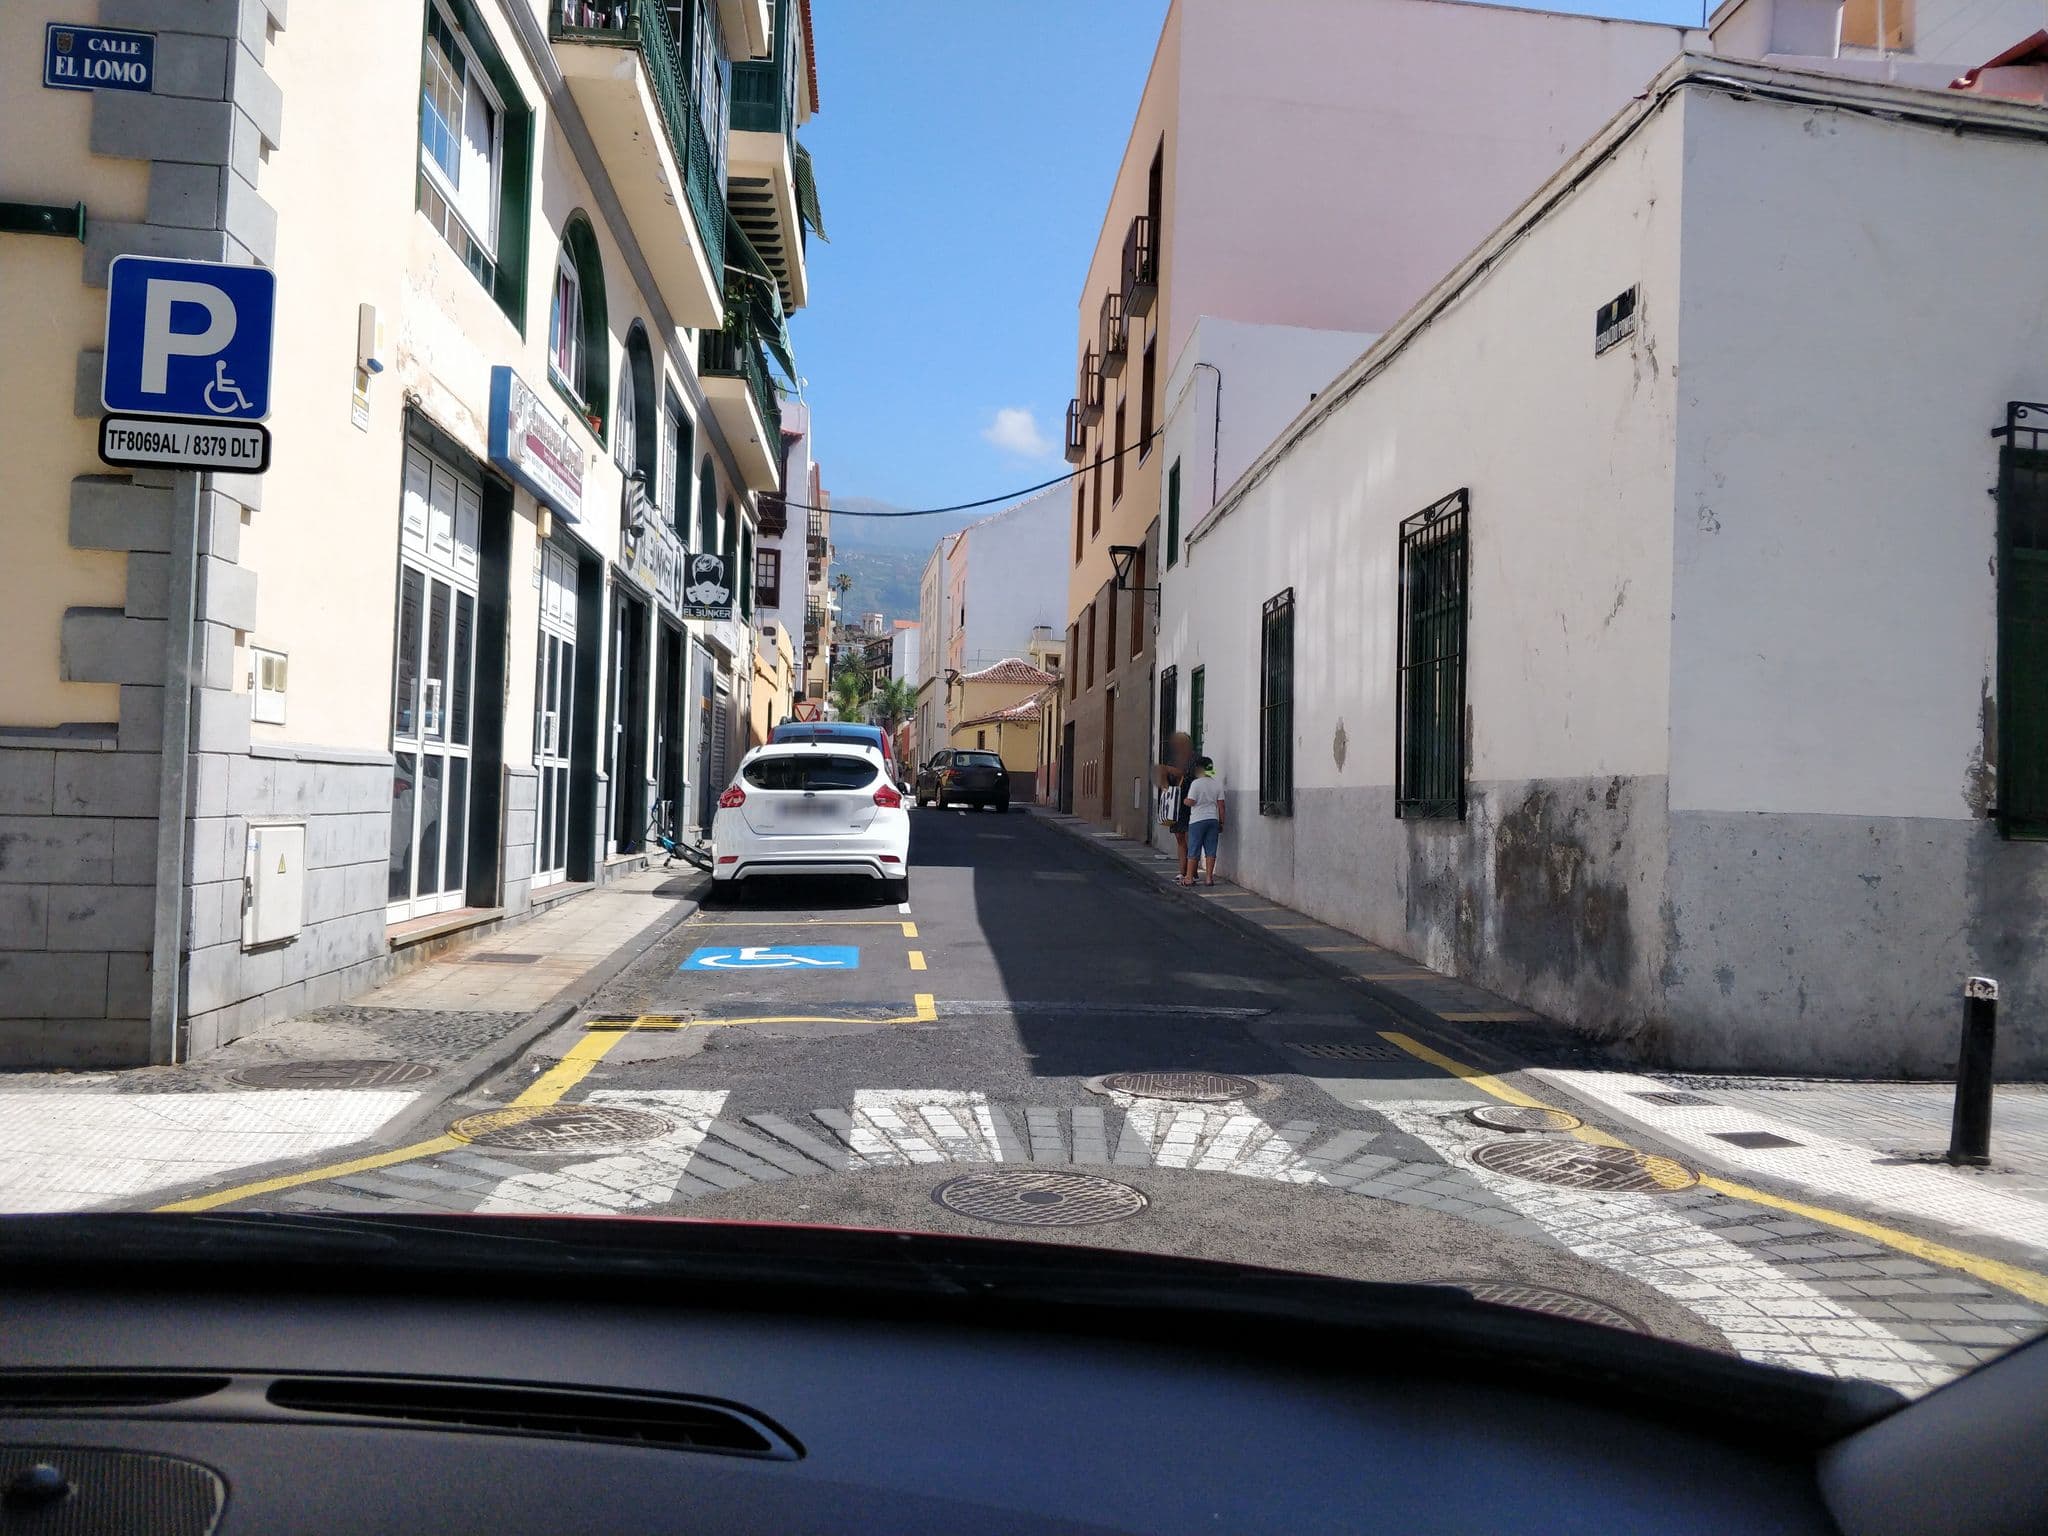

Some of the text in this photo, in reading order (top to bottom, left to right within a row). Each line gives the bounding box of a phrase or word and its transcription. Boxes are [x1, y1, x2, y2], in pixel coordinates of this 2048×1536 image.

[88, 38, 140, 54] CALLE
[55, 56, 147, 83] EL LOMO
[140, 278, 237, 394] P
[109, 429, 259, 458] TF8069AL / 8379 DLT
[683, 607, 731, 618] EL BUNKER
